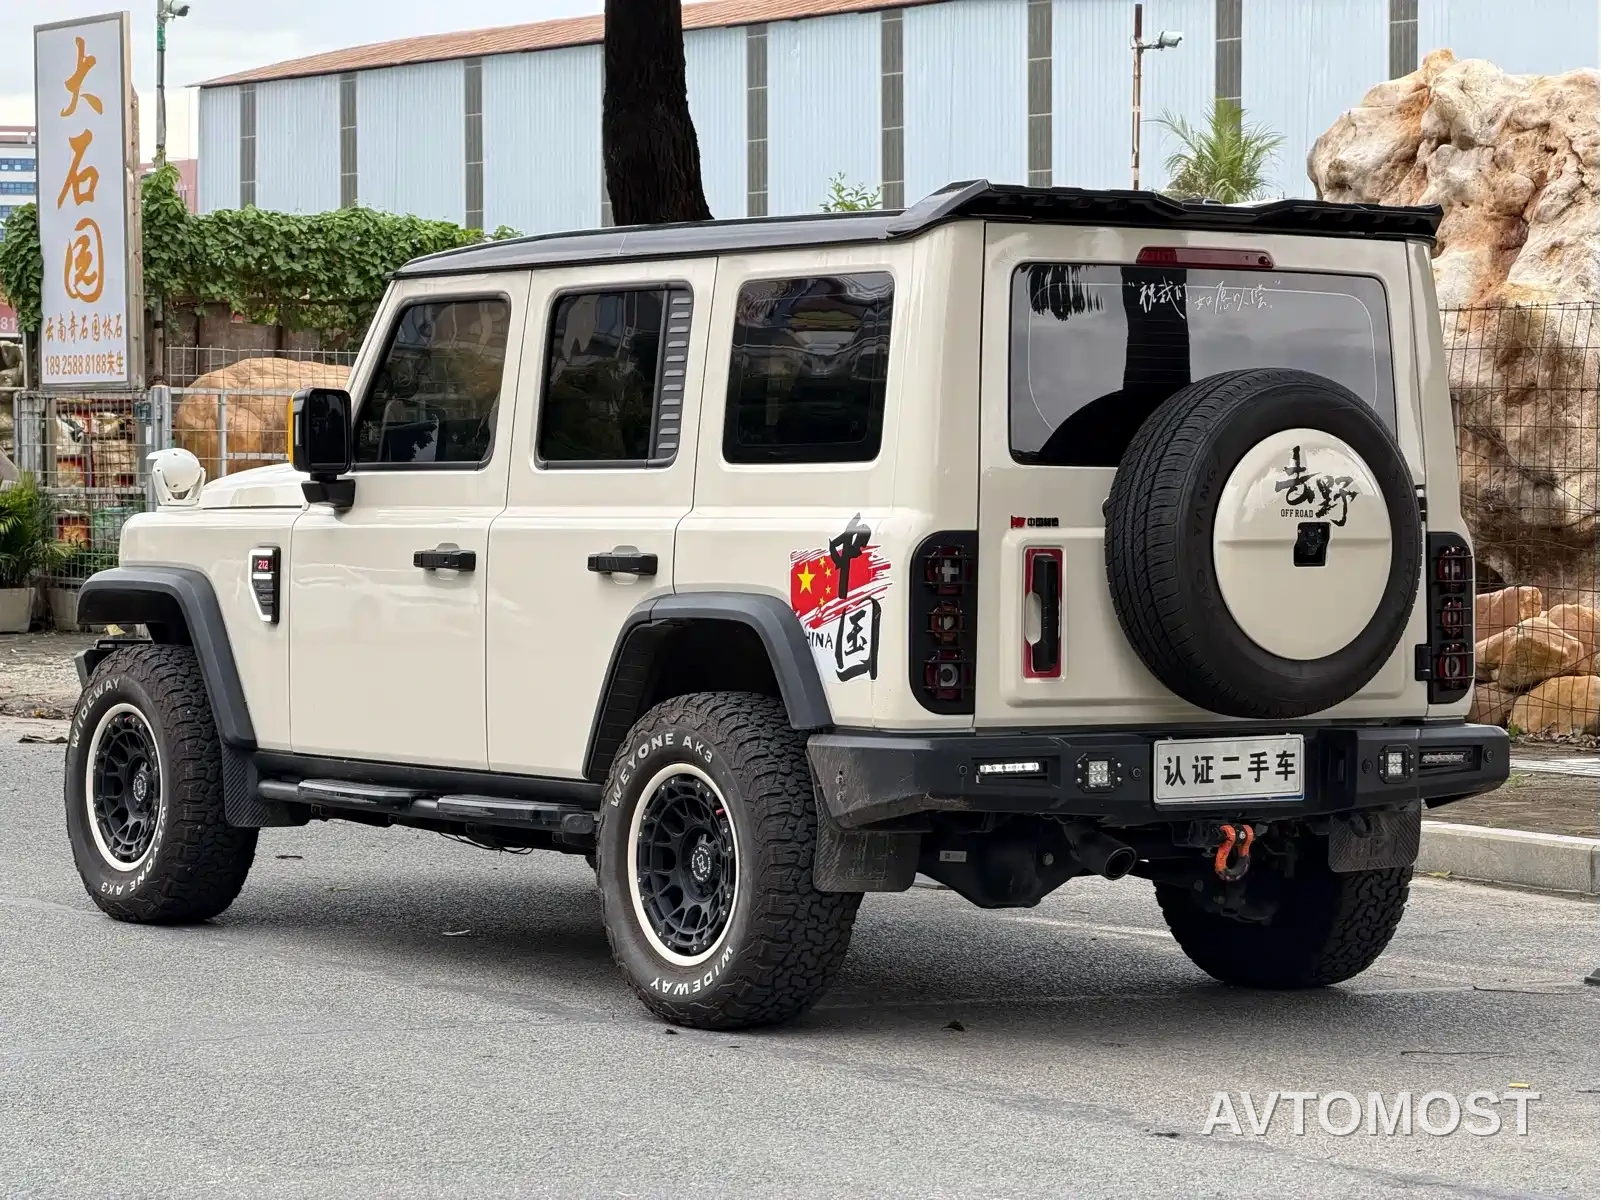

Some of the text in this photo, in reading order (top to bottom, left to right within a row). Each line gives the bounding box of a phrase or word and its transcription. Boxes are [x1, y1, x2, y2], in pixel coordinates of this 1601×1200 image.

[1280, 508, 1314, 518] OFF ROAD
[258, 560, 269, 570] 212
[829, 512, 882, 682] 中国
[804, 631, 833, 650] HINA
[71, 677, 121, 749] WIDEWAY
[611, 732, 713, 808] WEYONE AK3
[1163, 750, 1296, 786] 认证二手车
[101, 881, 124, 896] AK3
[649, 945, 733, 996] WIDEWAY
